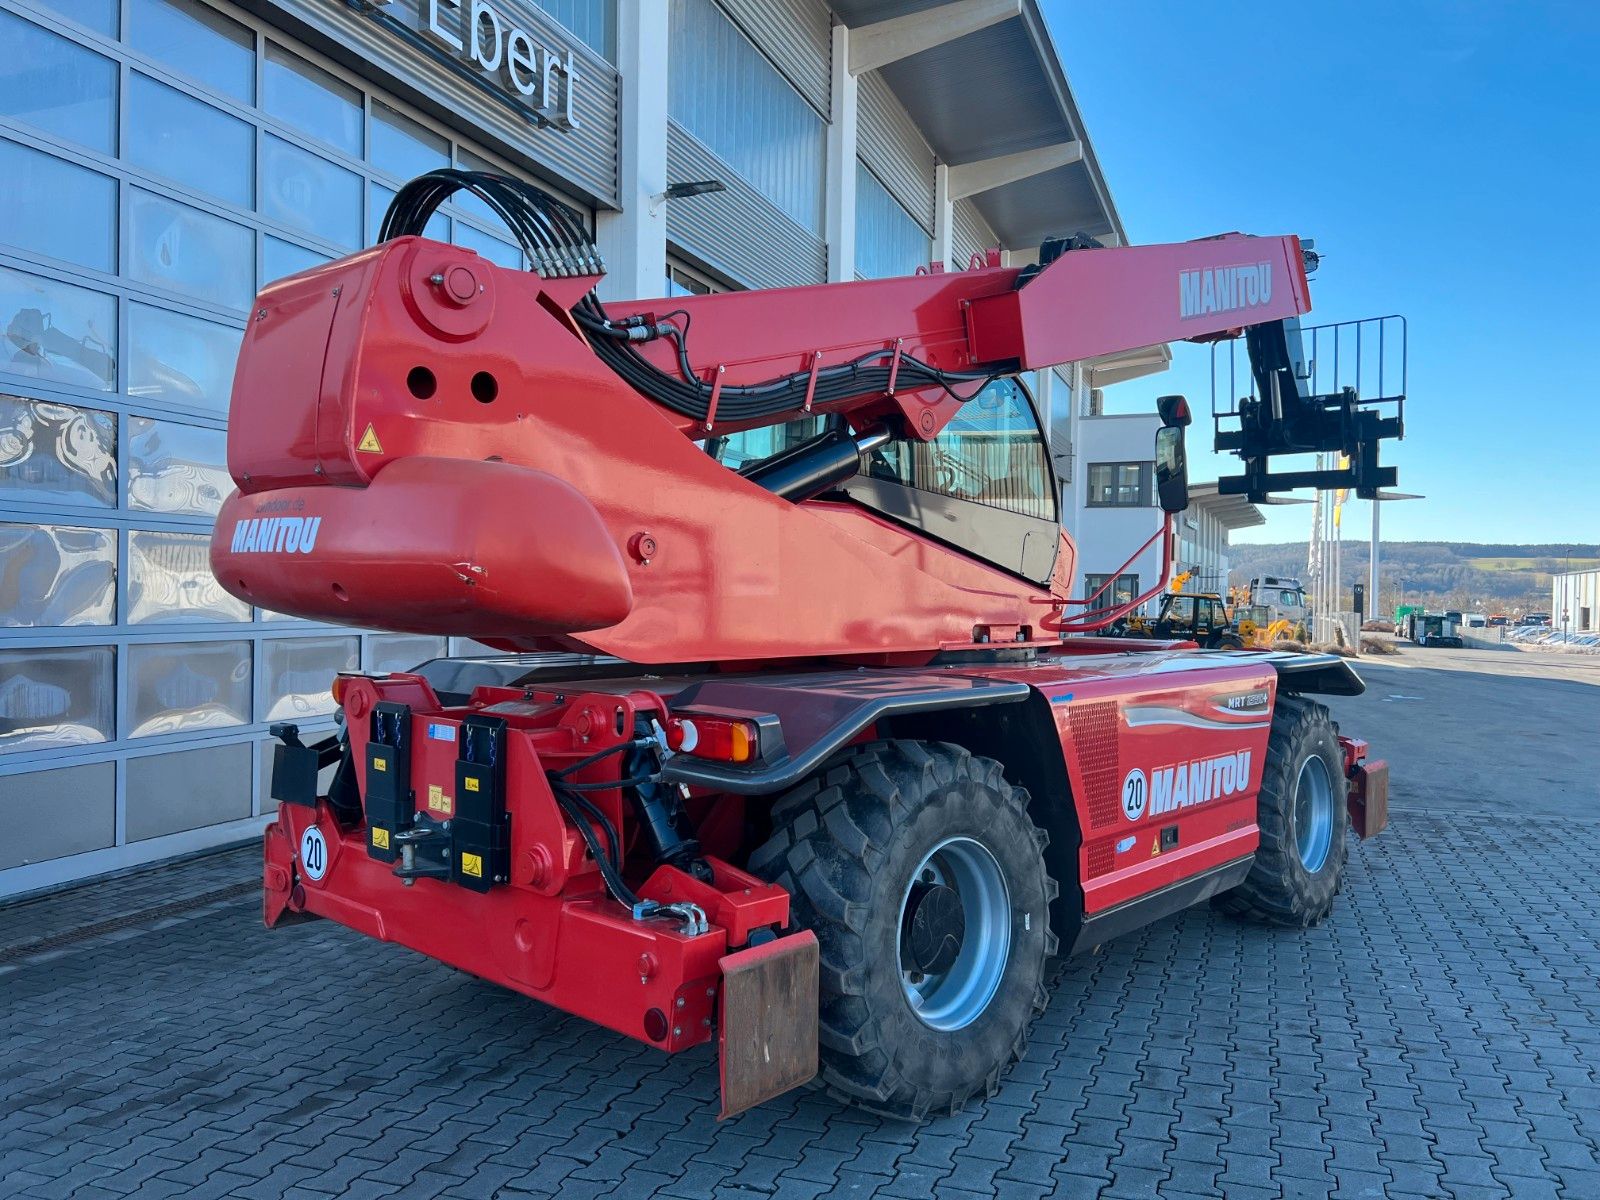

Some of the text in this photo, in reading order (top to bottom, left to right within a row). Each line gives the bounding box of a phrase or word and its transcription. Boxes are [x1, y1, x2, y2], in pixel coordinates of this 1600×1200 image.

[1180, 261, 1272, 317] MANITOU
[231, 516, 322, 554] MANITOU
[1228, 695, 1246, 709] MRT
[1127, 777, 1143, 812] 20
[1149, 749, 1252, 817] MANITOU
[306, 835, 322, 872] 20
